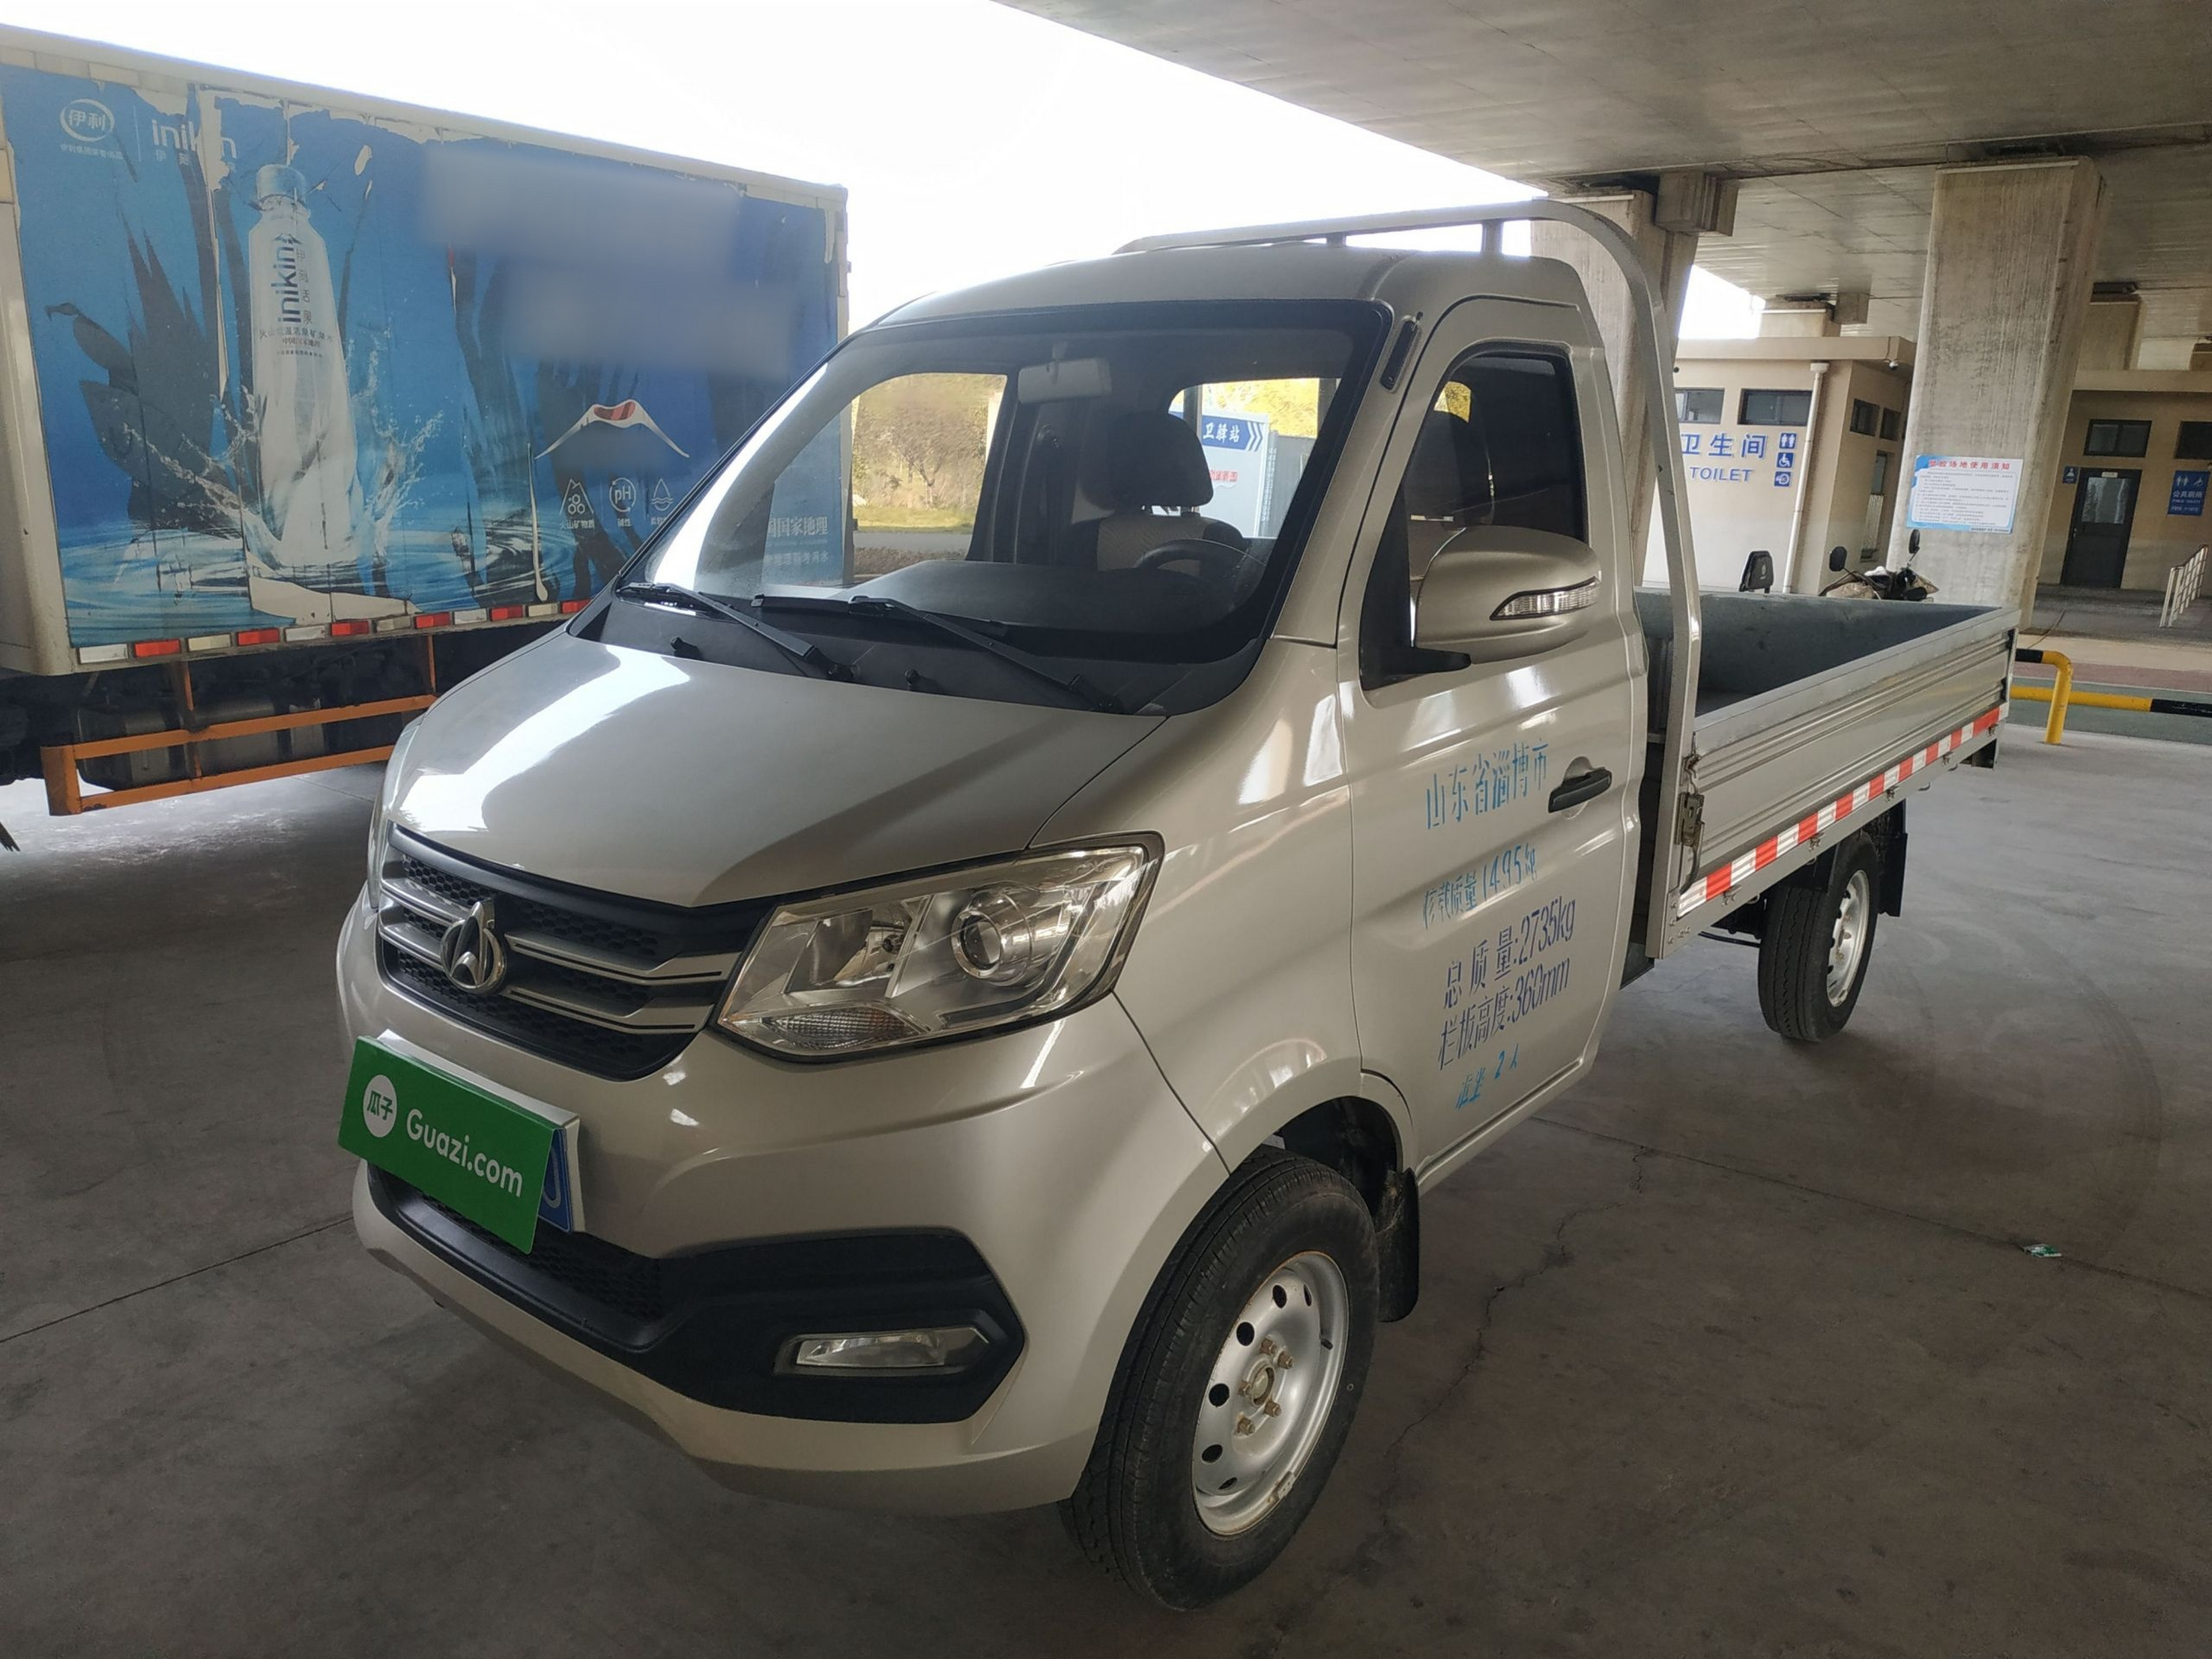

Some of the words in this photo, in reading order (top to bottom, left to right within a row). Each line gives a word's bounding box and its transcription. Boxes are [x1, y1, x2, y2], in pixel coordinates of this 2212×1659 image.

[68, 109, 105, 131] 伊利
[271, 247, 301, 323] inikin
[1681, 433, 1767, 459] 卫生间
[1690, 467, 1753, 482] TOILET
[615, 486, 631, 505] pH
[1426, 737, 1548, 830] 山东省淄博市
[367, 1090, 393, 1121] 瓜子
[406, 1108, 523, 1198] Guazi.com
